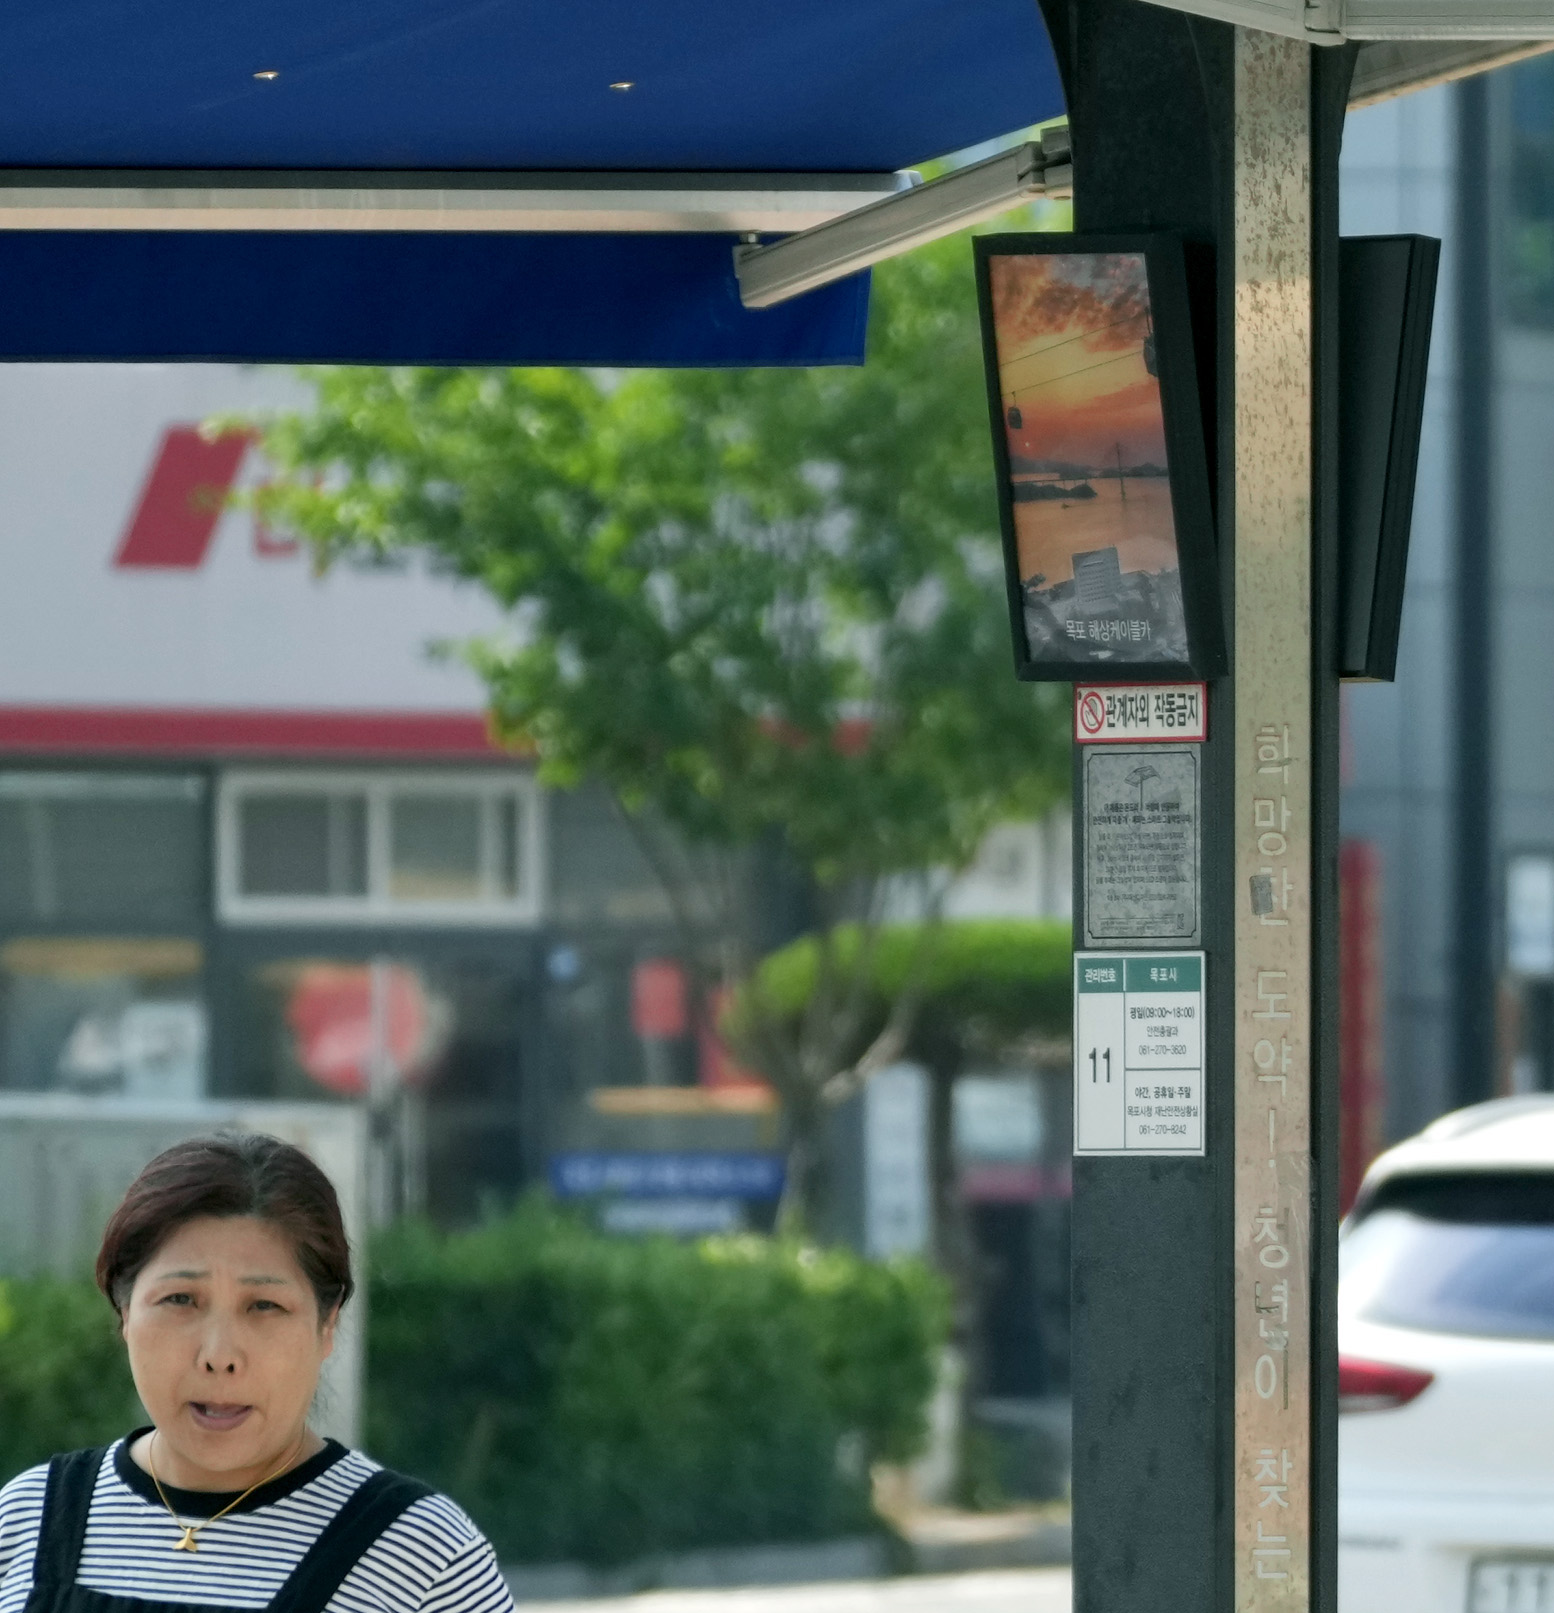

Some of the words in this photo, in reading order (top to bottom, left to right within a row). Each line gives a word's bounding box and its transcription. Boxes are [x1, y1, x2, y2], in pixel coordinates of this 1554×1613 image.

[1066, 620, 1086, 641] 목포
[1088, 619, 1151, 641] 해상케이블카
[1105, 693, 1149, 728] 관계자외
[1154, 692, 1199, 728] 작동금지
[1084, 967, 1117, 984] 관리번호
[1150, 966, 1177, 982] 목포시
[1088, 1047, 1111, 1083] 11
[1252, 1448, 1294, 1579] 찾는
